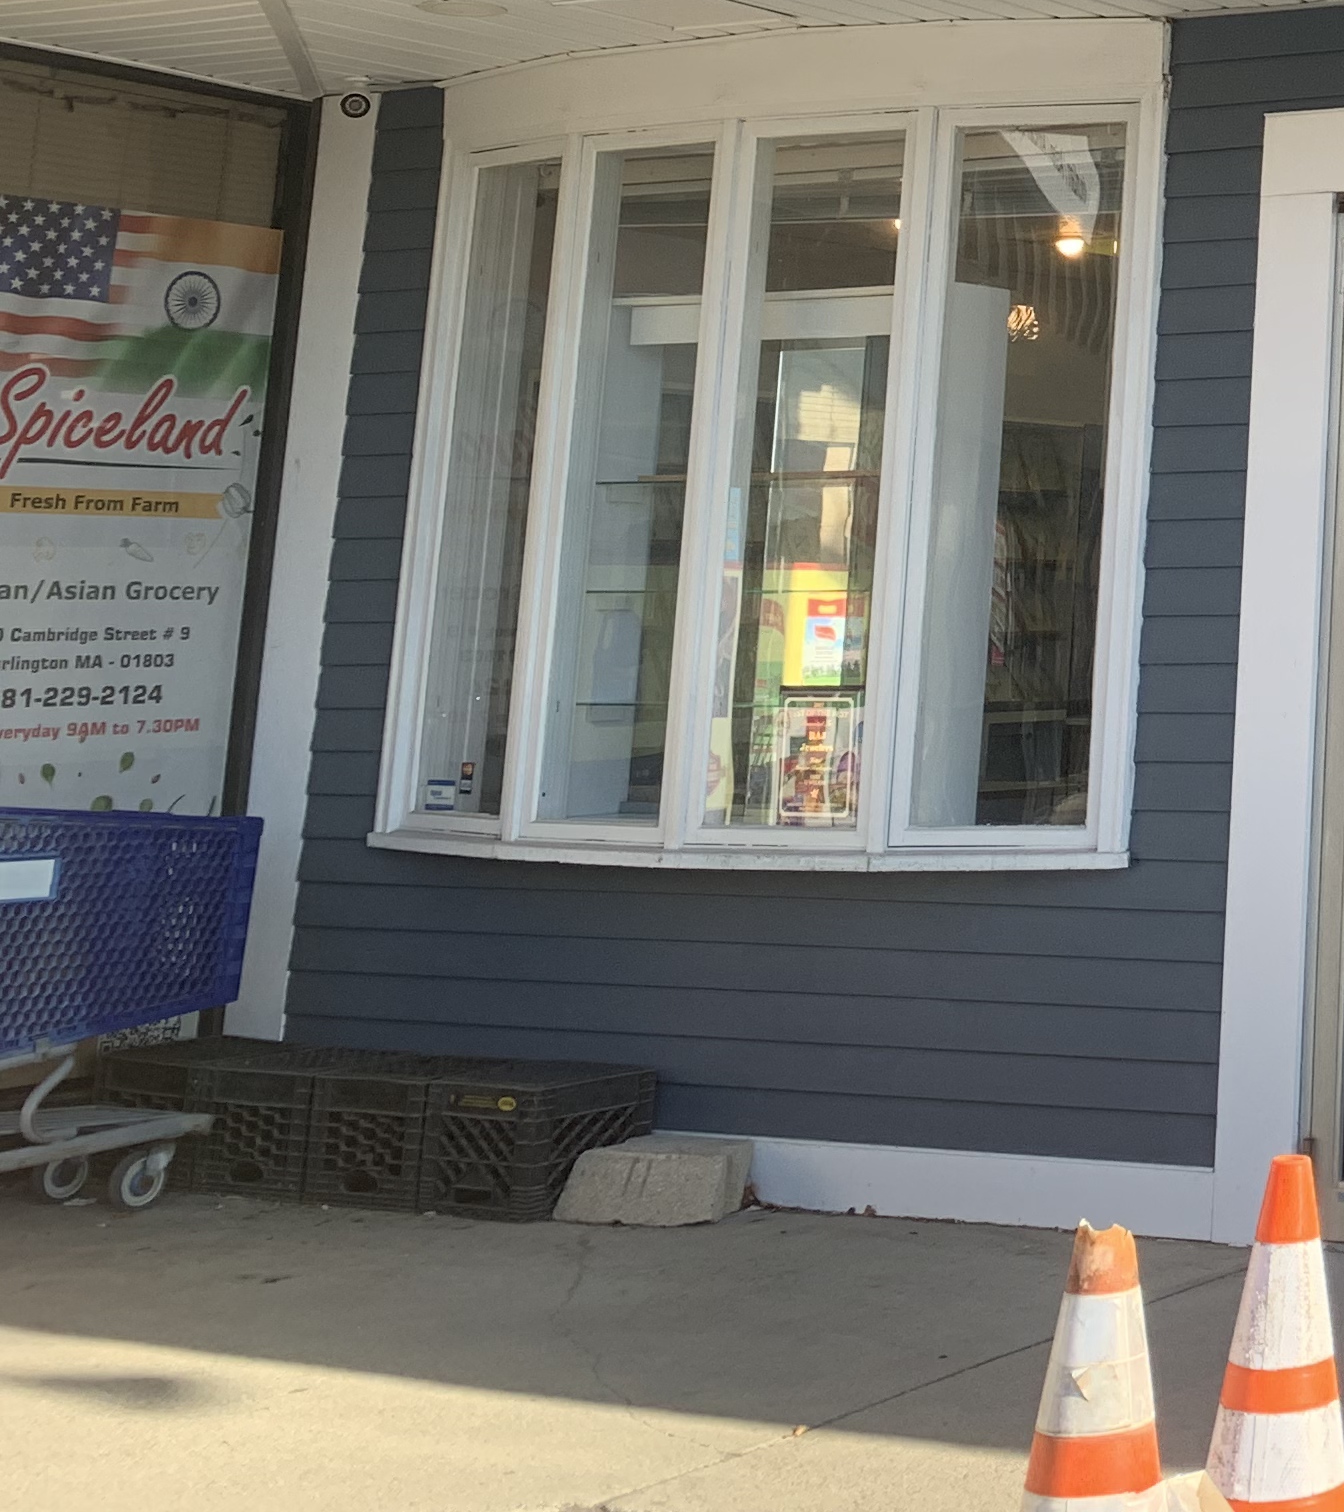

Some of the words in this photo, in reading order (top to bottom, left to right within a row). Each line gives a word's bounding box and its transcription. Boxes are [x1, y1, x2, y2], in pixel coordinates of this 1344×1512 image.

[0, 366, 249, 480] Spiceland
[9, 492, 66, 510] Fresh
[73, 494, 124, 512] From
[130, 496, 180, 513] Farm
[0, 579, 116, 605] an/Asian
[125, 580, 220, 606] Grocery
[10, 627, 98, 644] Cambridge
[103, 626, 157, 641] Street
[179, 626, 191, 640] 9
[0, 656, 69, 673] rlington
[75, 654, 103, 669] MA
[120, 653, 175, 668] 01803
[0, 684, 163, 709] 81-229-2124
[0, 723, 61, 742] veryday
[67, 721, 107, 737] 9AM
[112, 722, 130, 735] to
[136, 717, 201, 735] 7.30PM
